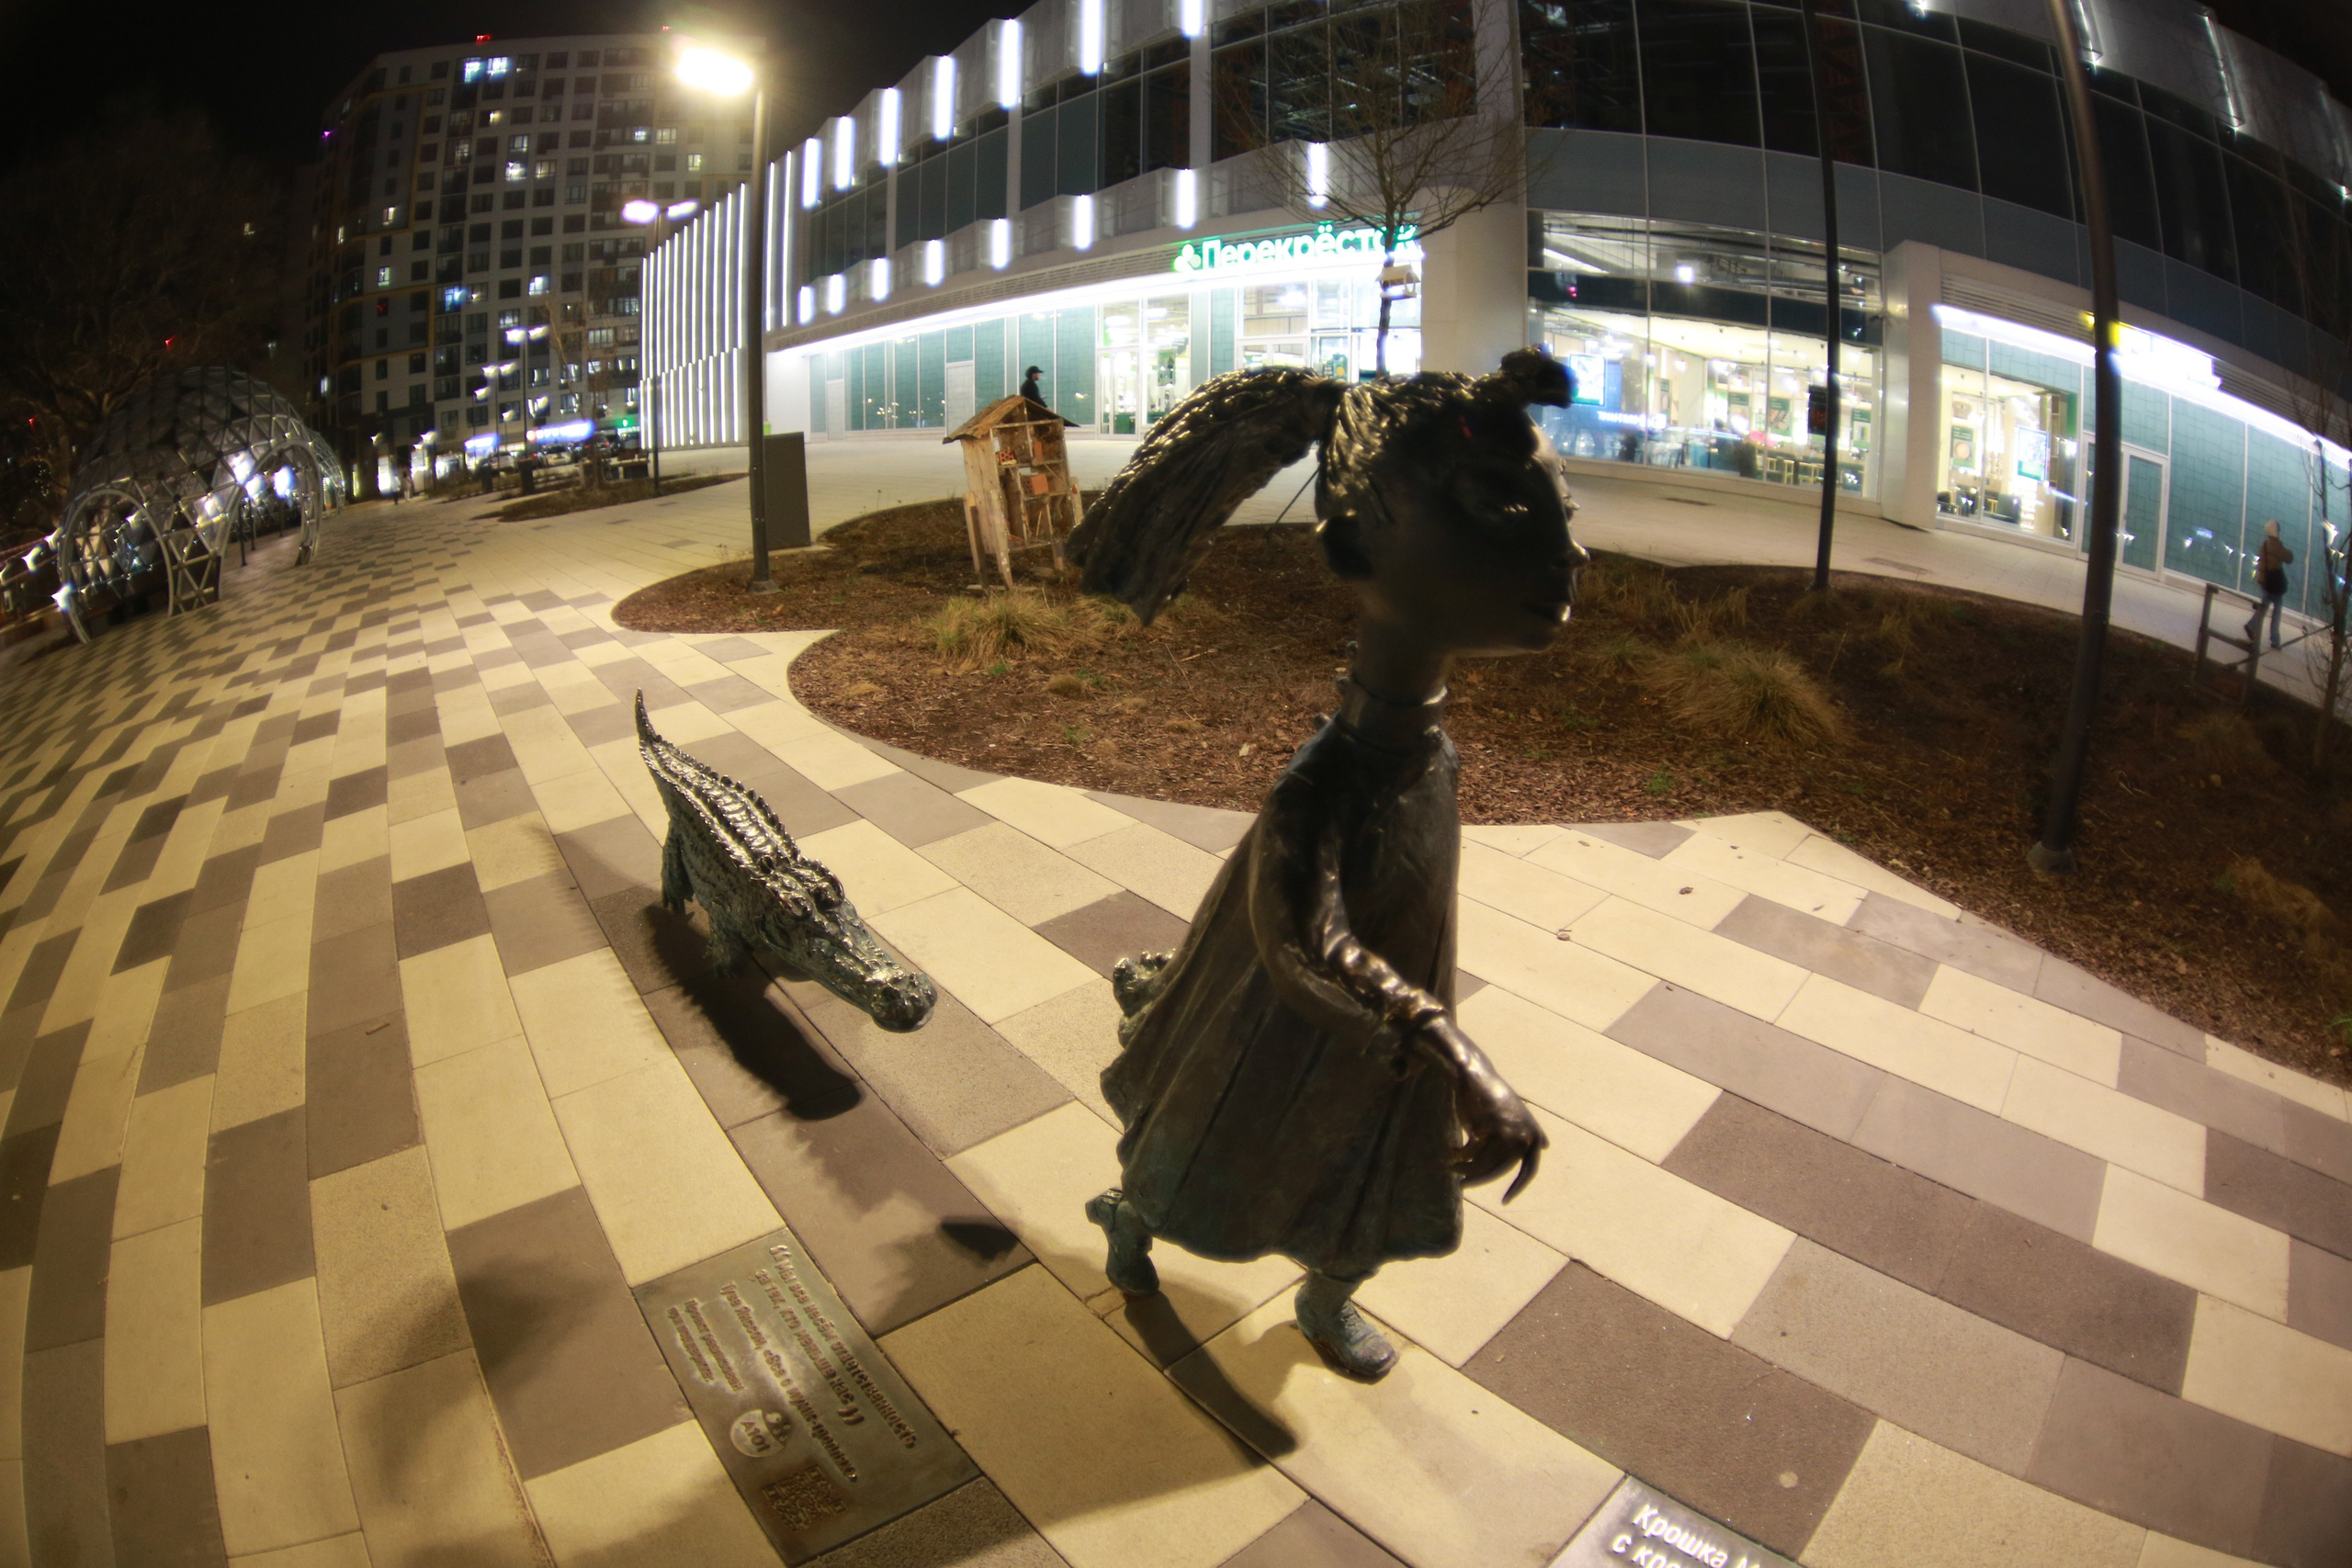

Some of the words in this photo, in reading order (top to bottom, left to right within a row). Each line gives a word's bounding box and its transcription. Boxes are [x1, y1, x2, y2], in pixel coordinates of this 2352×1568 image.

[831, 1340, 918, 1449] ответственность
[1612, 1534, 1633, 1553] с
[1633, 1505, 1728, 1568] Крошка
